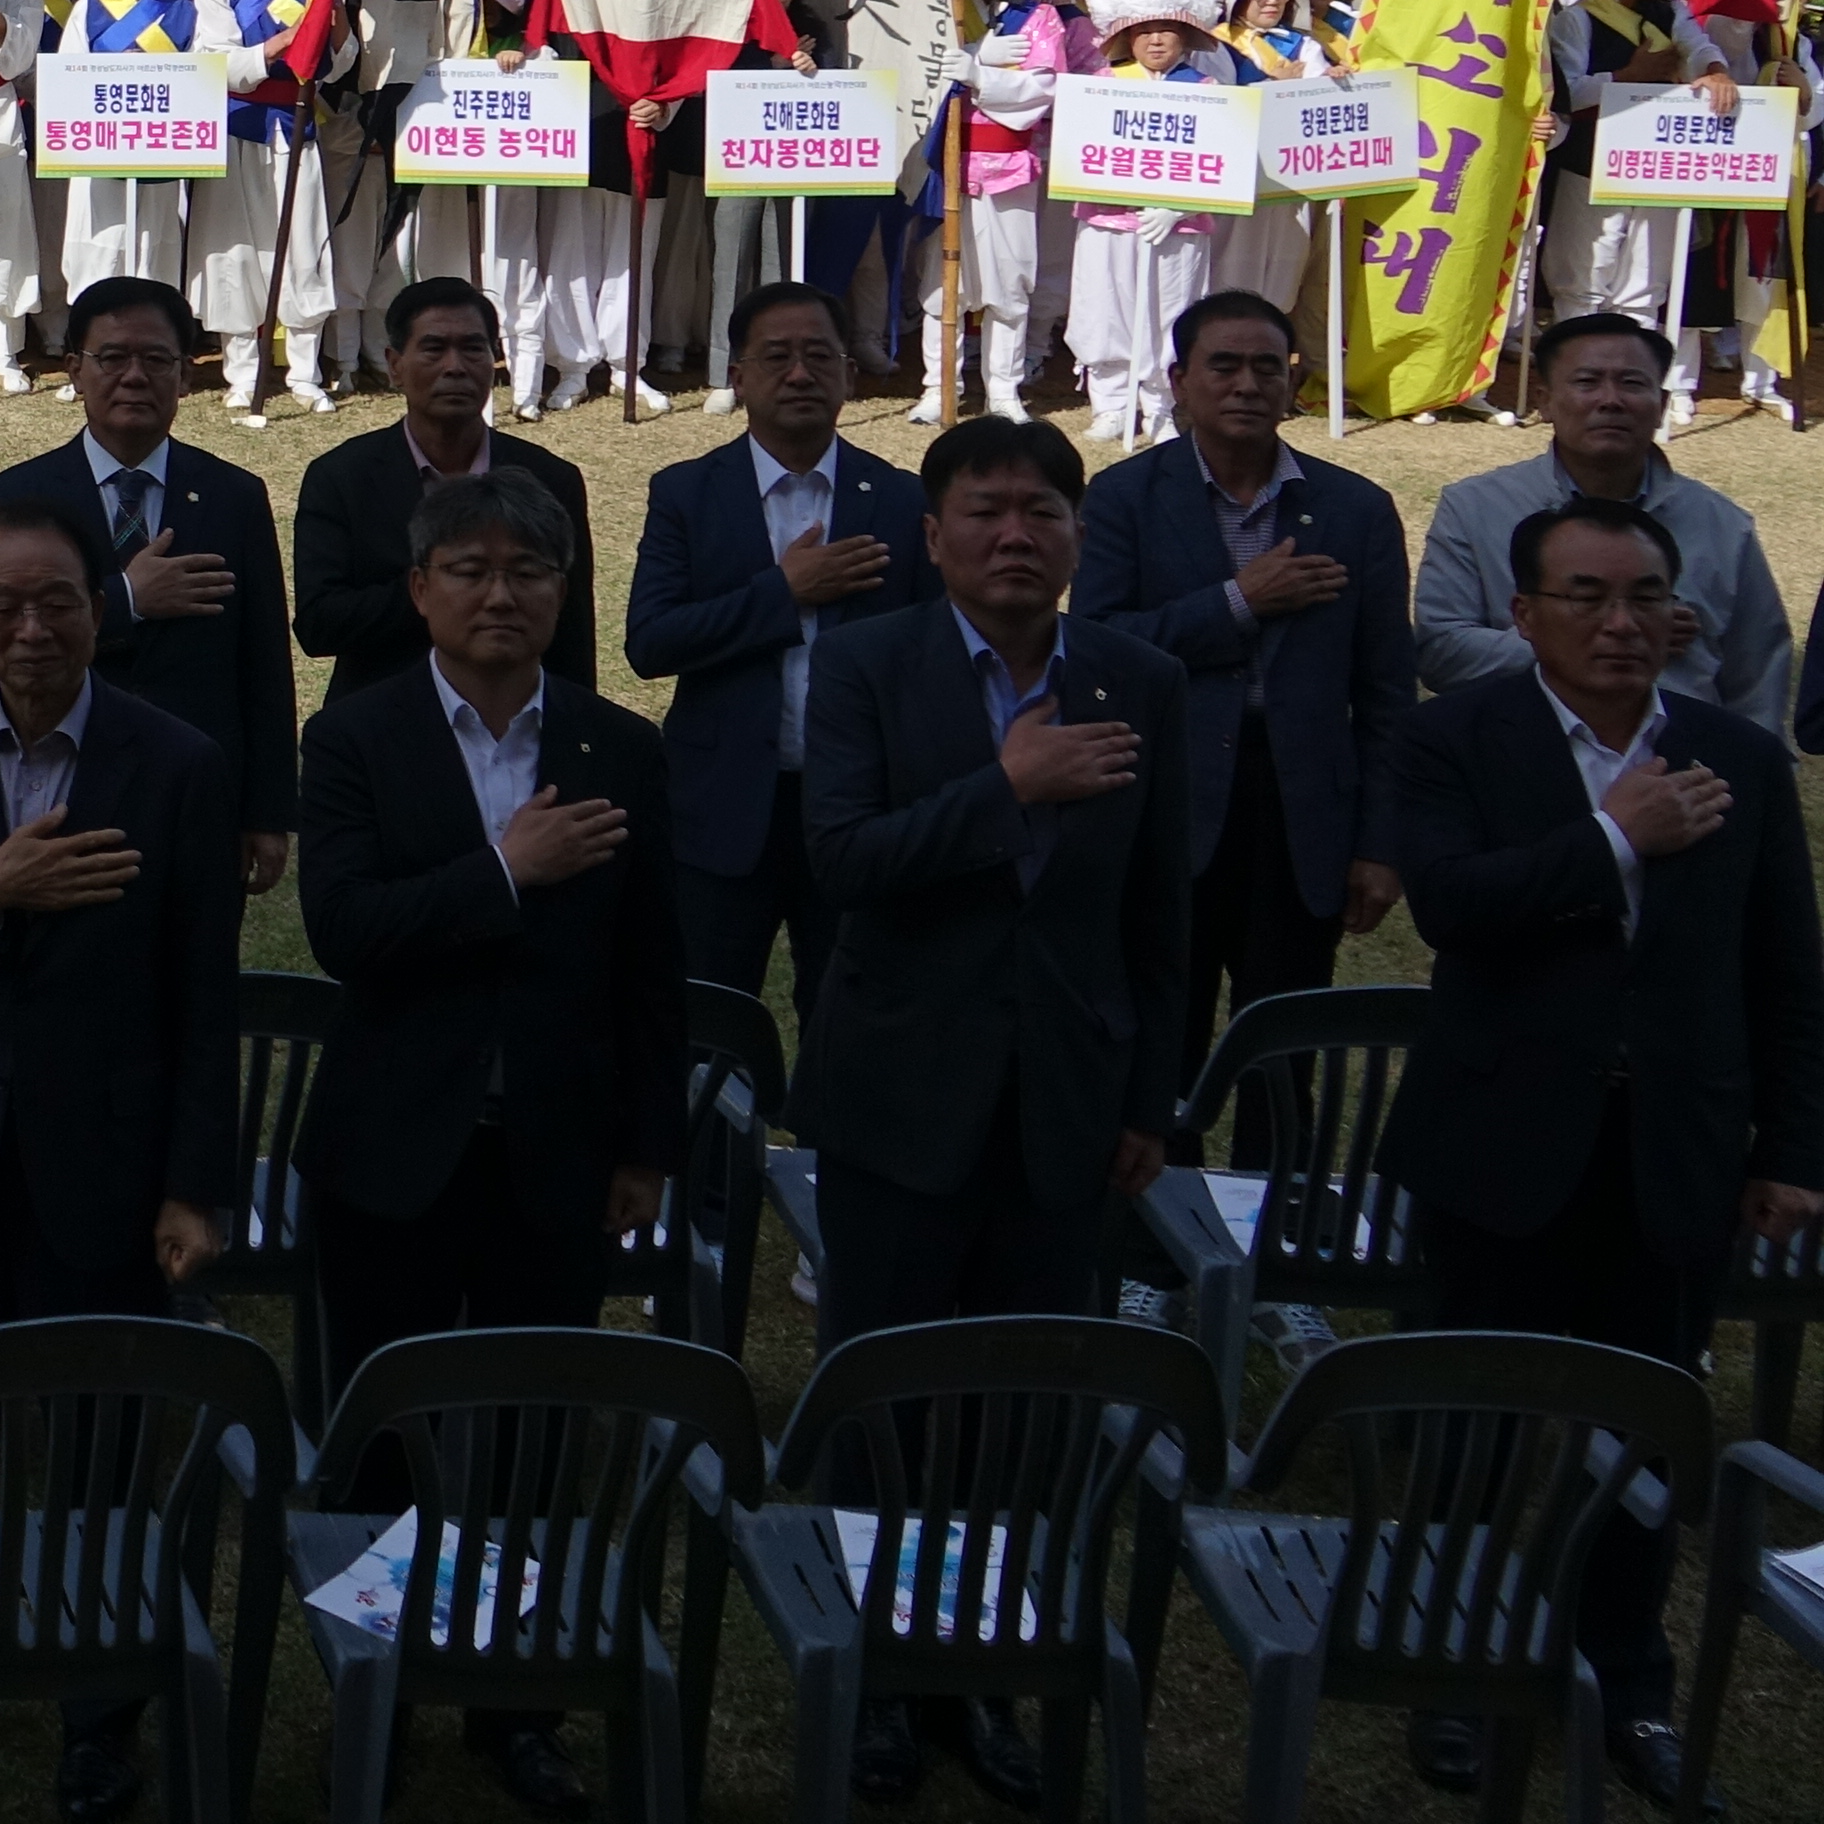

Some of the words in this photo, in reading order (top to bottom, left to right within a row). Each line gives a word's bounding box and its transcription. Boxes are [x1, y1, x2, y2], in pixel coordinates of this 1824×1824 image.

[64, 65, 89, 73] 제14회
[90, 64, 135, 73] 경상남도지사기
[137, 63, 198, 73] 어르신농악경연대회
[94, 84, 170, 114] 통영문화원
[760, 81, 806, 90] 경상남도지사기
[1110, 88, 1160, 100] 경상남도지사기
[452, 89, 532, 121] 진주문화원
[762, 100, 841, 131] 진해문화원
[1300, 101, 1370, 138] 창원문화원
[45, 120, 219, 151] 통영매구보존회
[407, 125, 487, 157] 이현동
[498, 127, 577, 159] 농악대
[1112, 108, 1198, 145] 마산문화원
[1655, 114, 1737, 146] 의령문화원
[721, 137, 882, 169] 천자봉연회단
[1080, 143, 1226, 185] 완월풍물단
[1278, 135, 1395, 176] 가야소리패
[1606, 148, 1779, 184] 의령집돌금농악보존회
